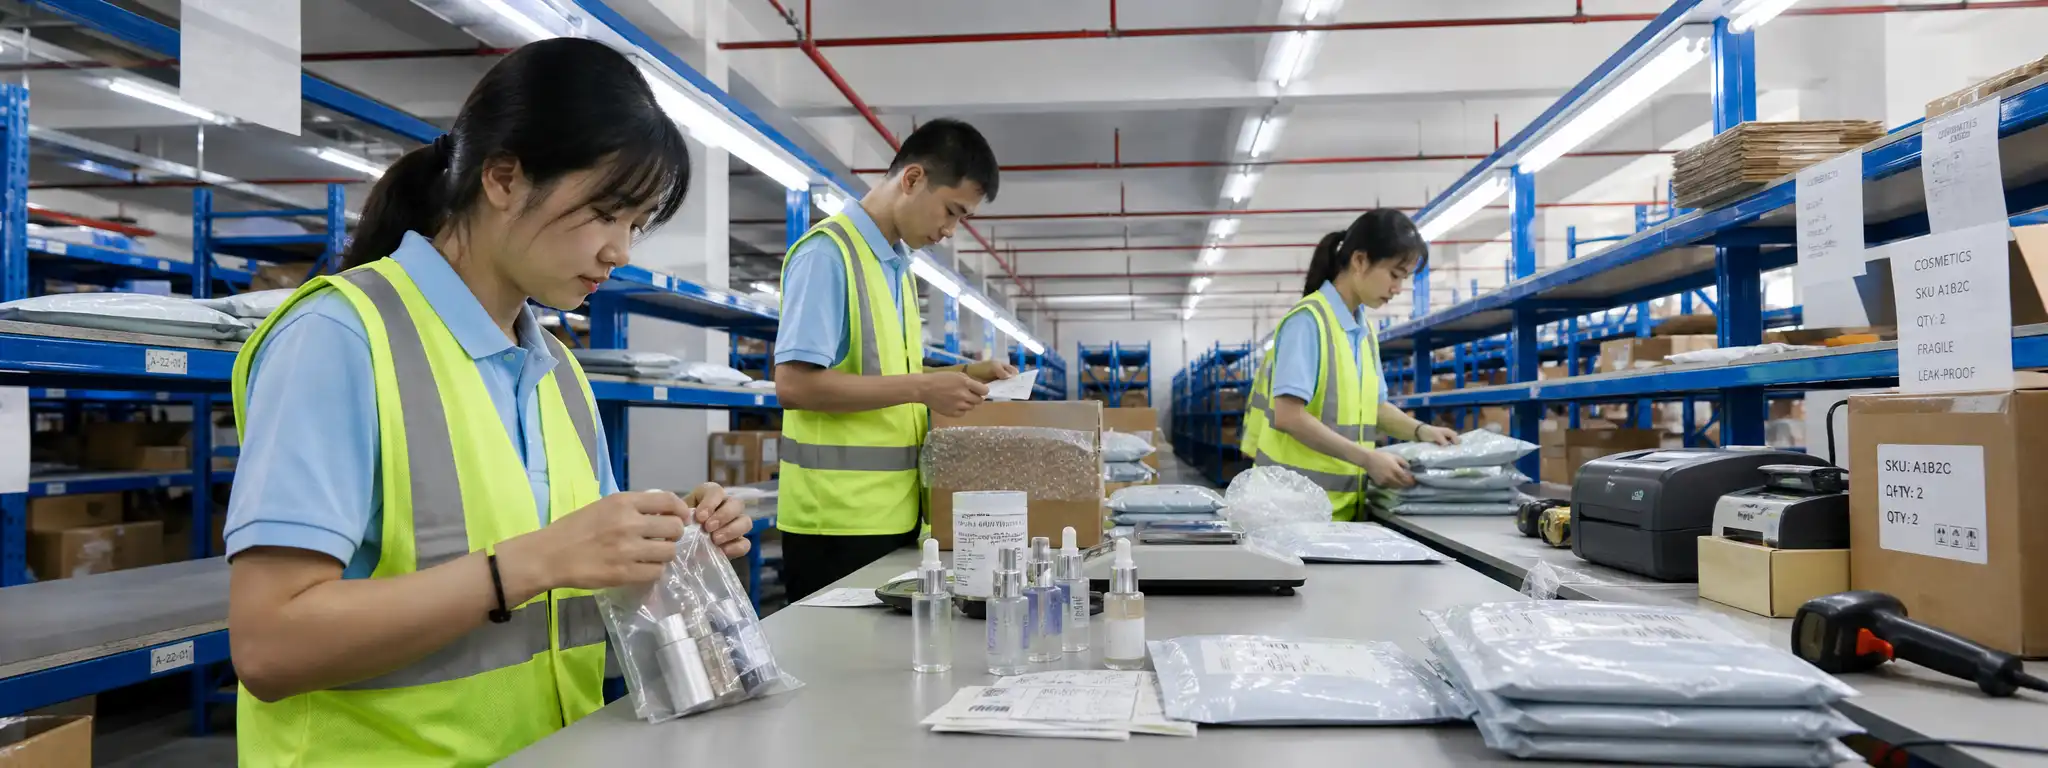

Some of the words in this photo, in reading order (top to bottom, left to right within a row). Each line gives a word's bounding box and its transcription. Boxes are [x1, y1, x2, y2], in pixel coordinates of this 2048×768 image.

[1914, 250, 1972, 271] COSMETICS
[1915, 286, 1935, 300] SKU
[1938, 280, 1970, 295] A1B2C
[1916, 314, 1938, 328] QTY:
[1940, 313, 1946, 325] 2
[1917, 341, 1954, 355] FRAGILE
[1918, 367, 1976, 382] LEAK-PROOF
[1885, 460, 1911, 472] SKU:
[1913, 461, 1952, 474] A1B2C
[1917, 487, 1924, 499] 2
[1887, 510, 1911, 524] QTY:
[1912, 513, 1919, 525] 2
